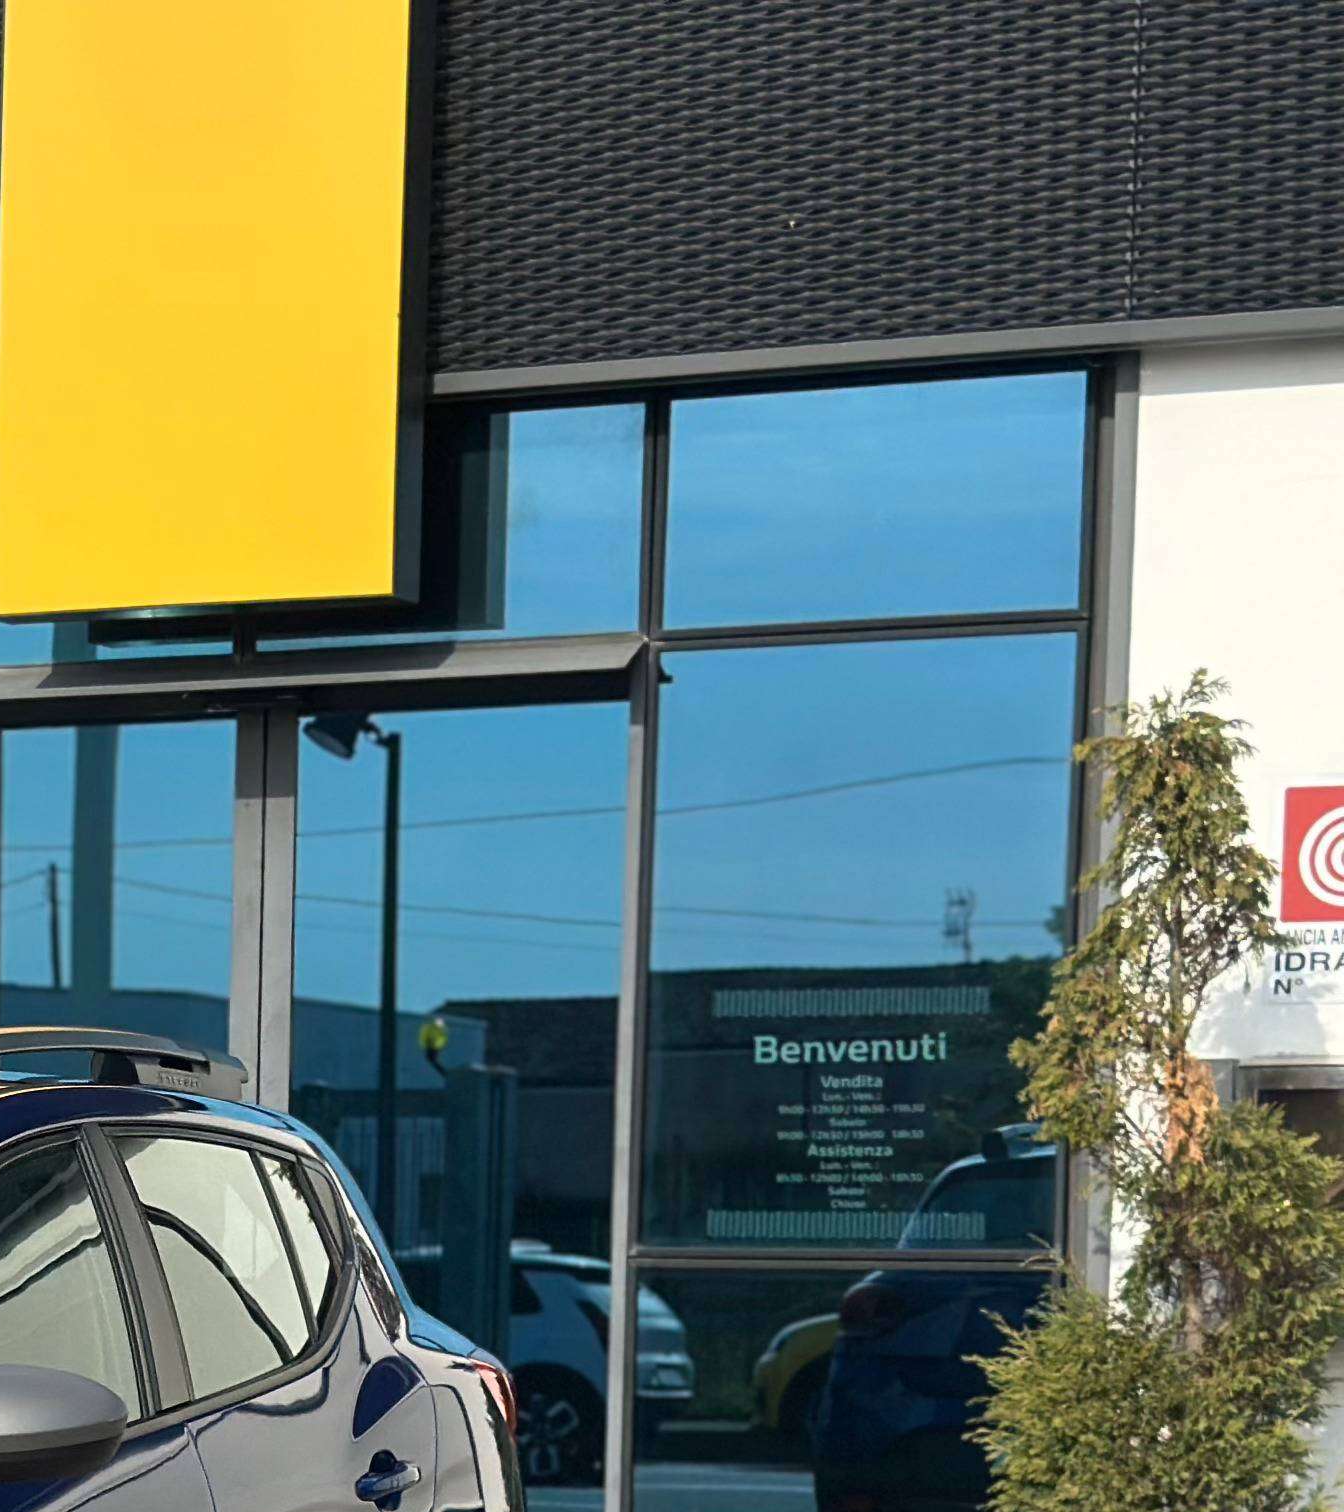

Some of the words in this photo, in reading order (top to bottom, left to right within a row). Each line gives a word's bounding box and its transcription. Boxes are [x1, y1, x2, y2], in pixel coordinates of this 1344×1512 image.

[753, 1032, 947, 1063] Benvenuti
[820, 1074, 884, 1088] Vendita
[807, 1143, 893, 1157] Assistenza
